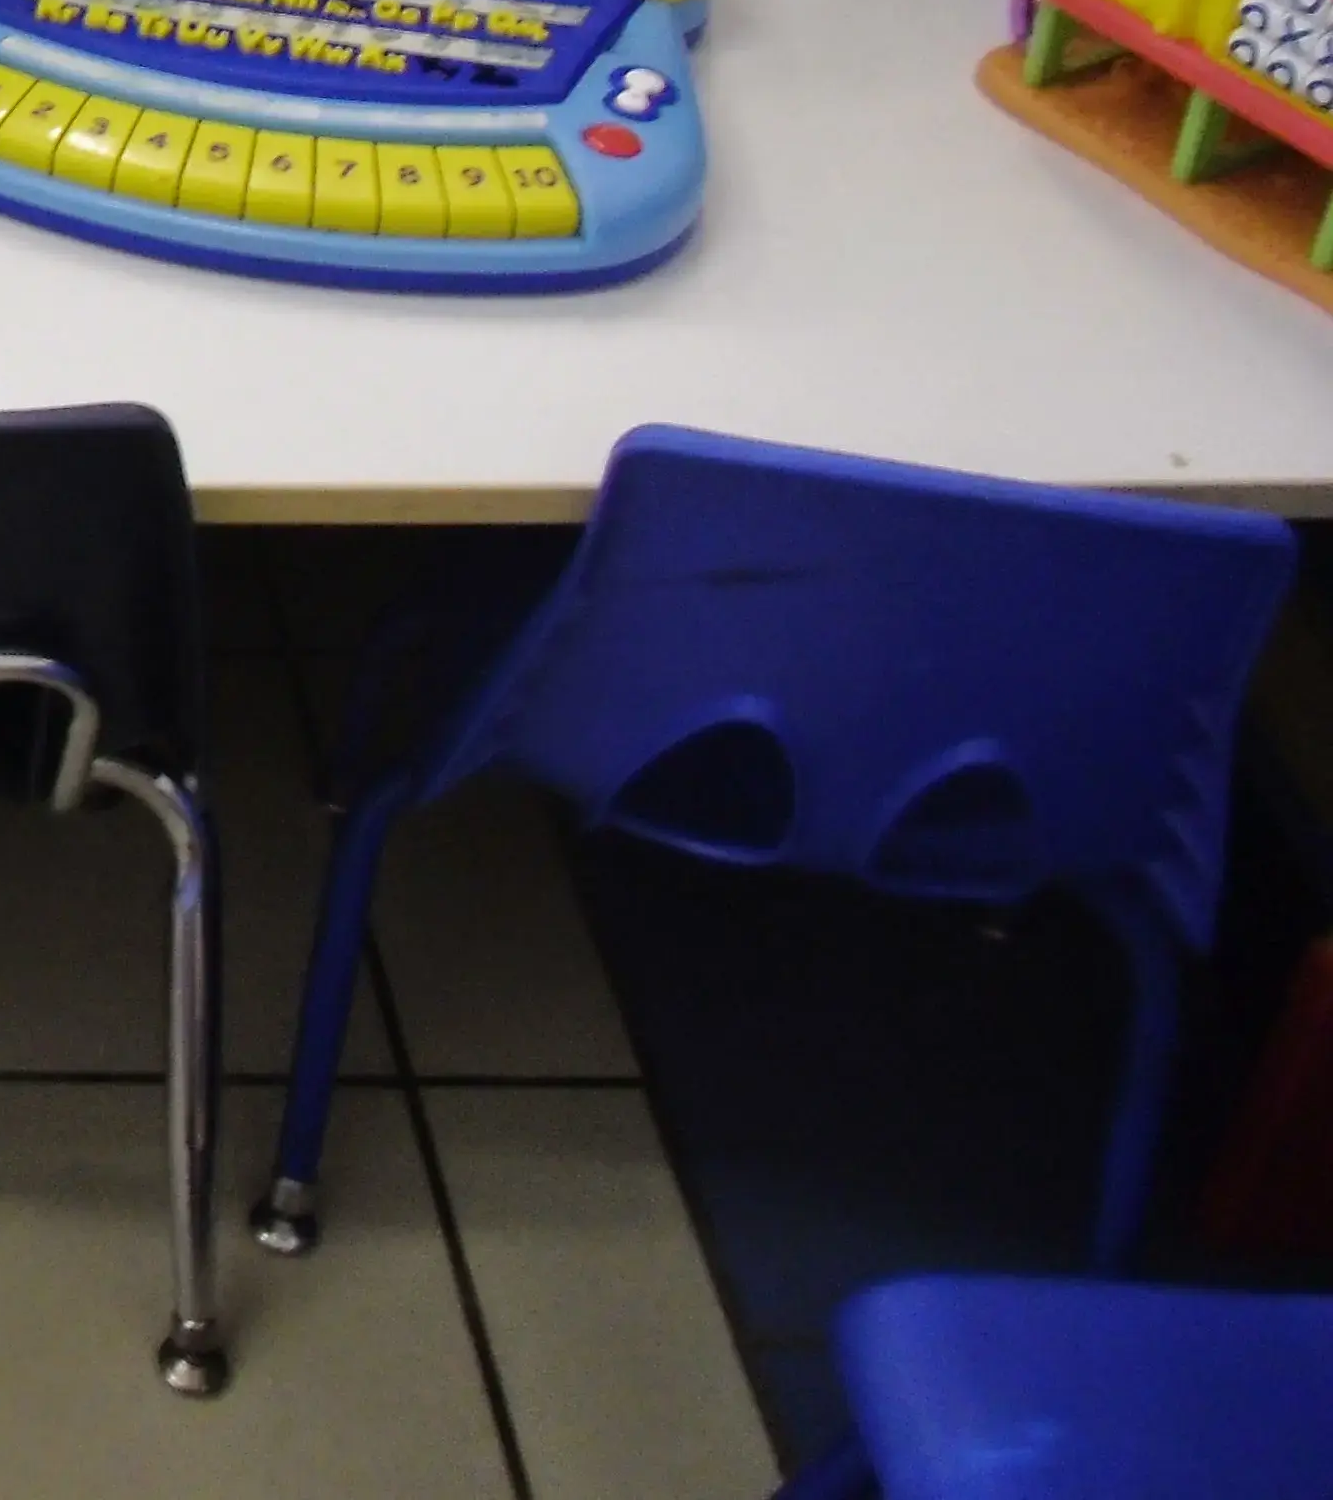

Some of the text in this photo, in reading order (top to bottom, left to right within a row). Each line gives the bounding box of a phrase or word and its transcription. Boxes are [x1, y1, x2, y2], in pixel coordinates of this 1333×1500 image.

[30, 101, 56, 118] 2
[89, 116, 110, 137] 3
[146, 131, 169, 150] 4
[270, 152, 293, 173] 6
[335, 158, 358, 180] 7
[397, 164, 420, 186] 8
[460, 166, 483, 187] 9
[513, 166, 559, 189] 10
